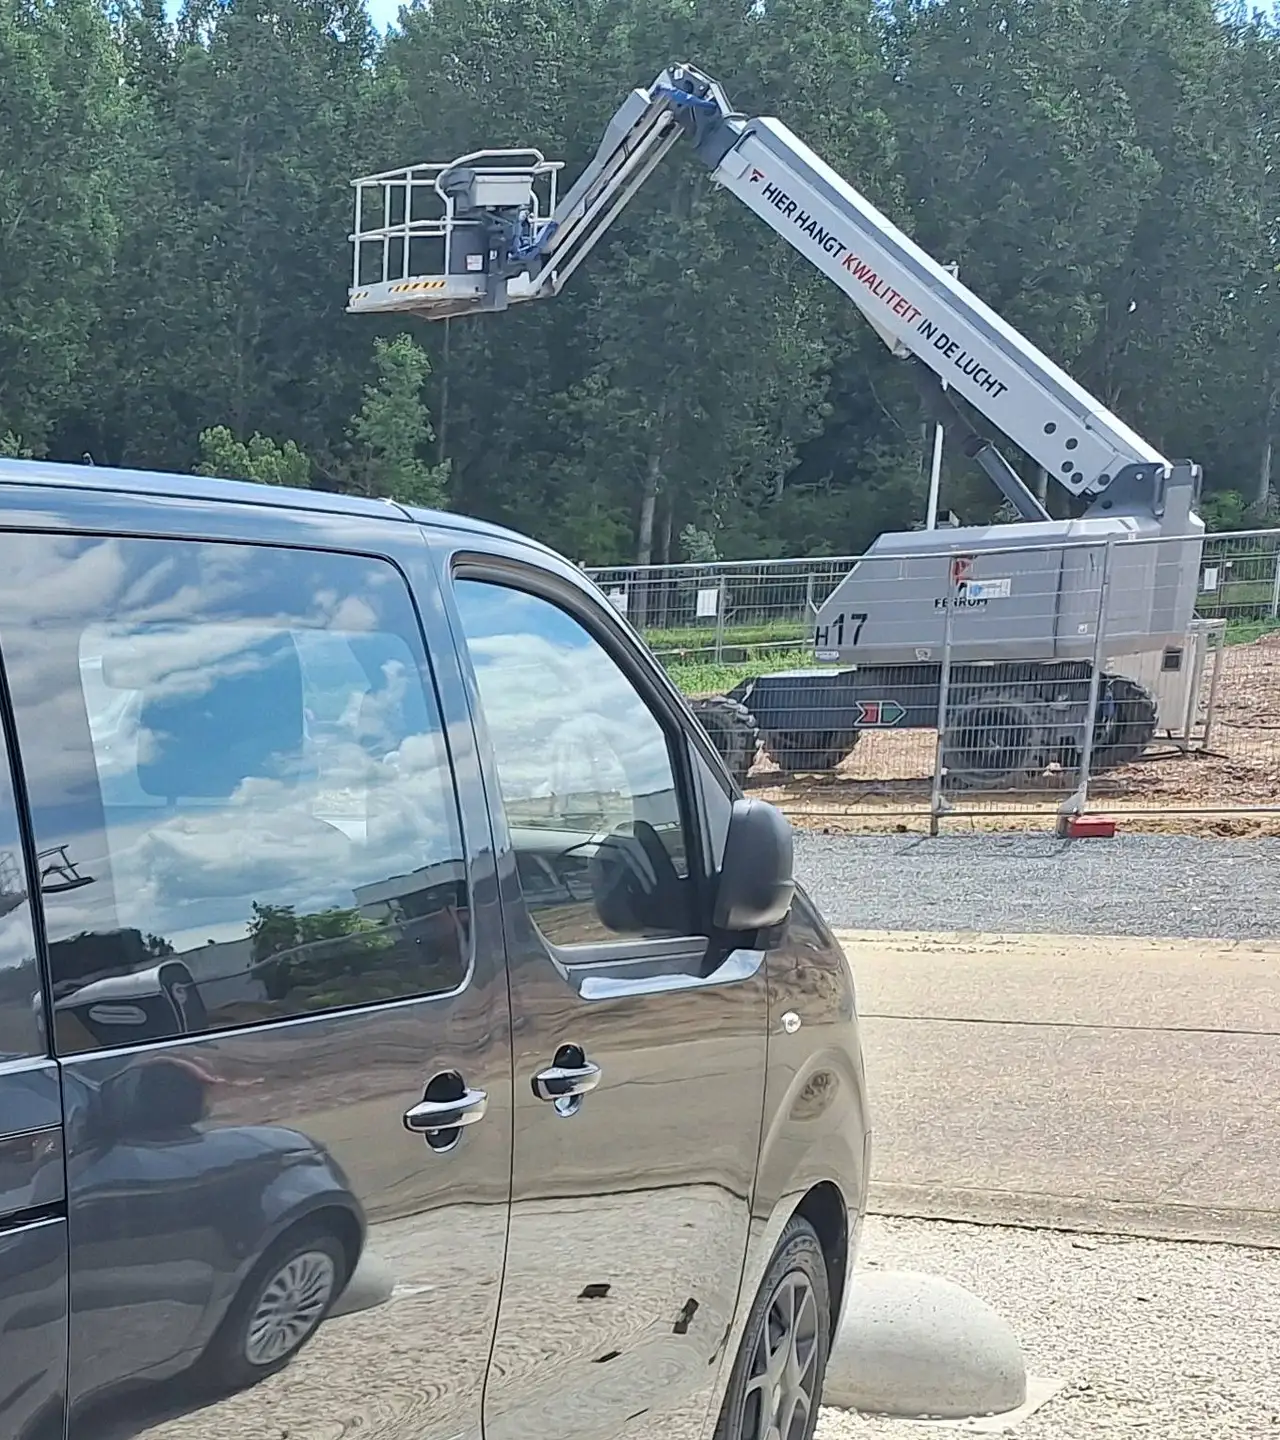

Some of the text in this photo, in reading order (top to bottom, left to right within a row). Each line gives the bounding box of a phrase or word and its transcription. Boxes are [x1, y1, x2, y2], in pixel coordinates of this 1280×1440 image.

[761, 182, 1008, 400] HIER HANGT KWALITEIT IN DE LUCHT
[815, 613, 868, 646] H17
